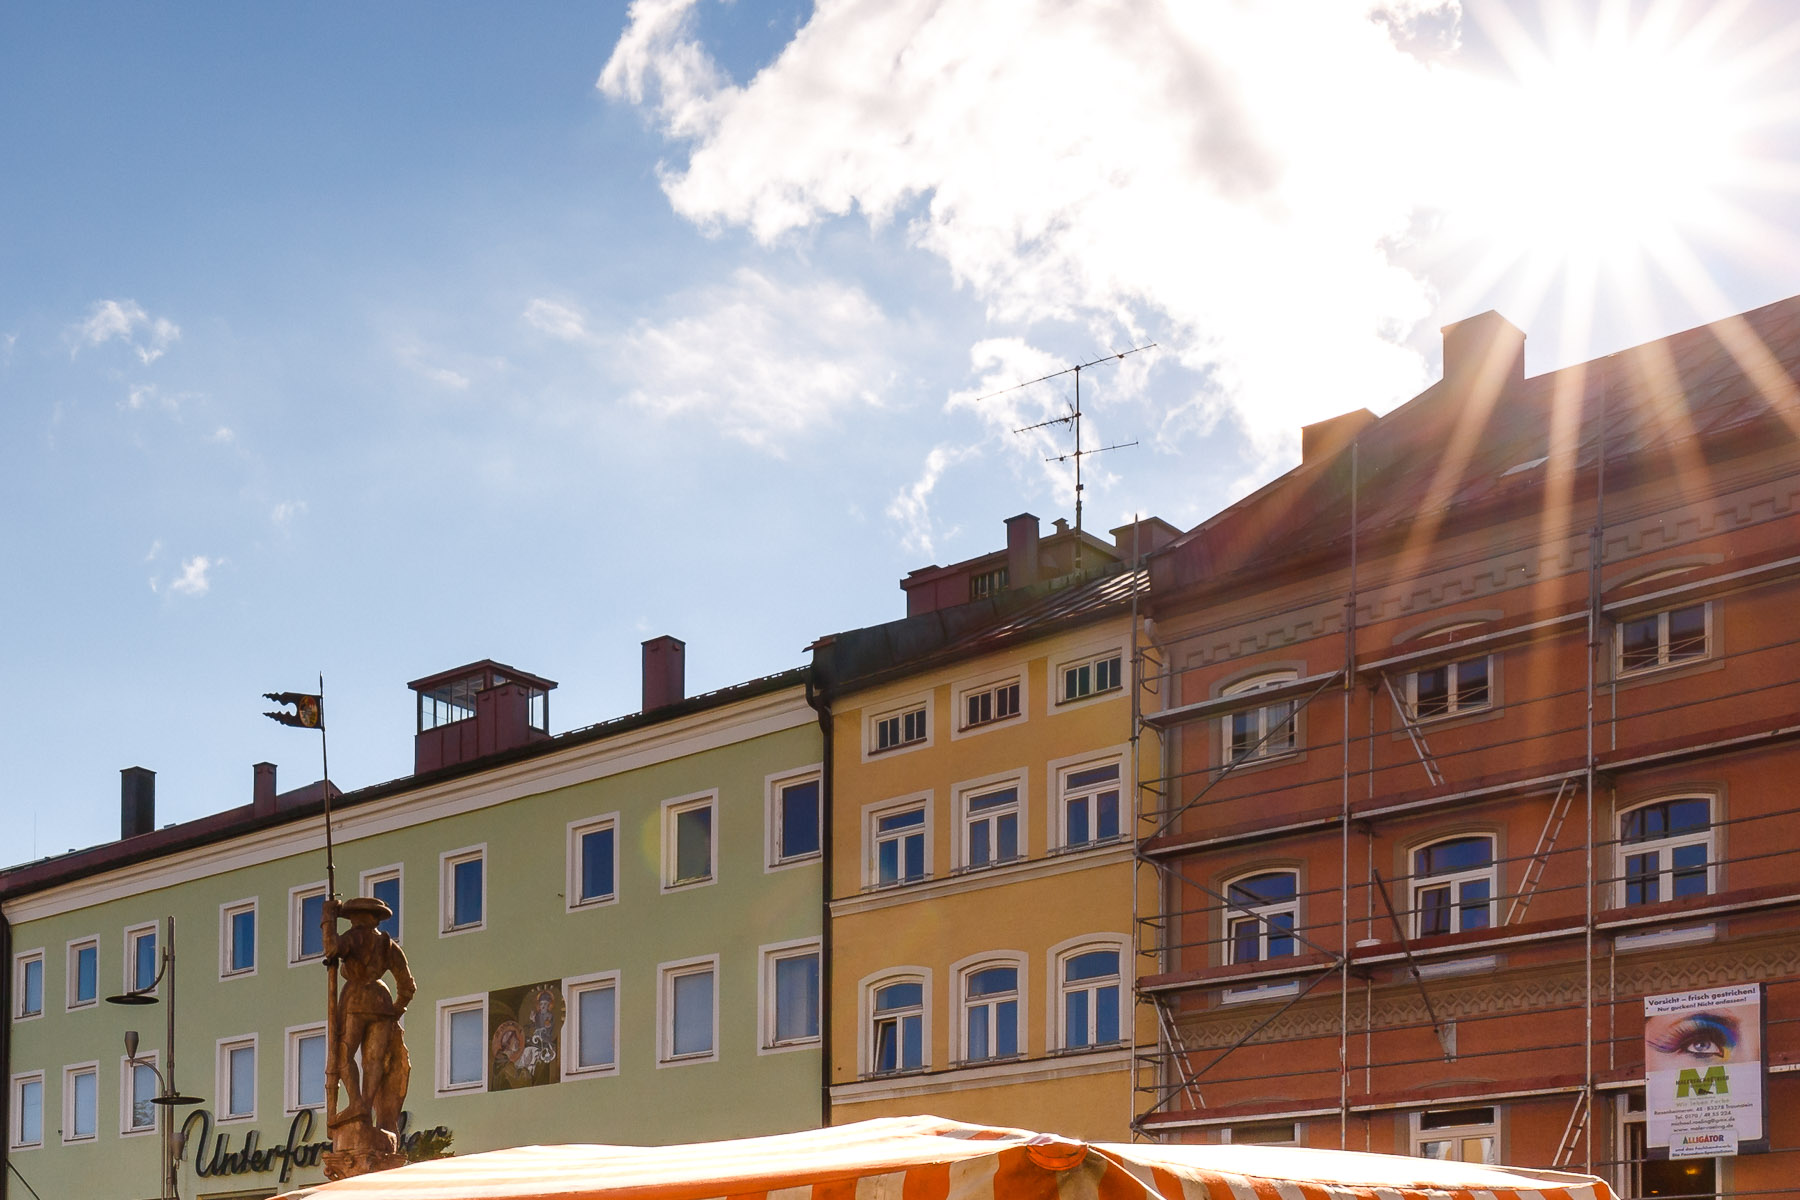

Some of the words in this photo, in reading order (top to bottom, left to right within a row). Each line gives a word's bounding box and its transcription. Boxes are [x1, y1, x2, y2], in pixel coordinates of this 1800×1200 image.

[1648, 996, 1680, 1006] Vorsicht
[1688, 993, 1710, 1002] frisch
[1711, 987, 1756, 1000] gestrichen!
[1670, 1003, 1696, 1012] gucken!
[1715, 997, 1747, 1005] anfassen!
[1682, 1134, 1725, 1145] ALLIGATOR
